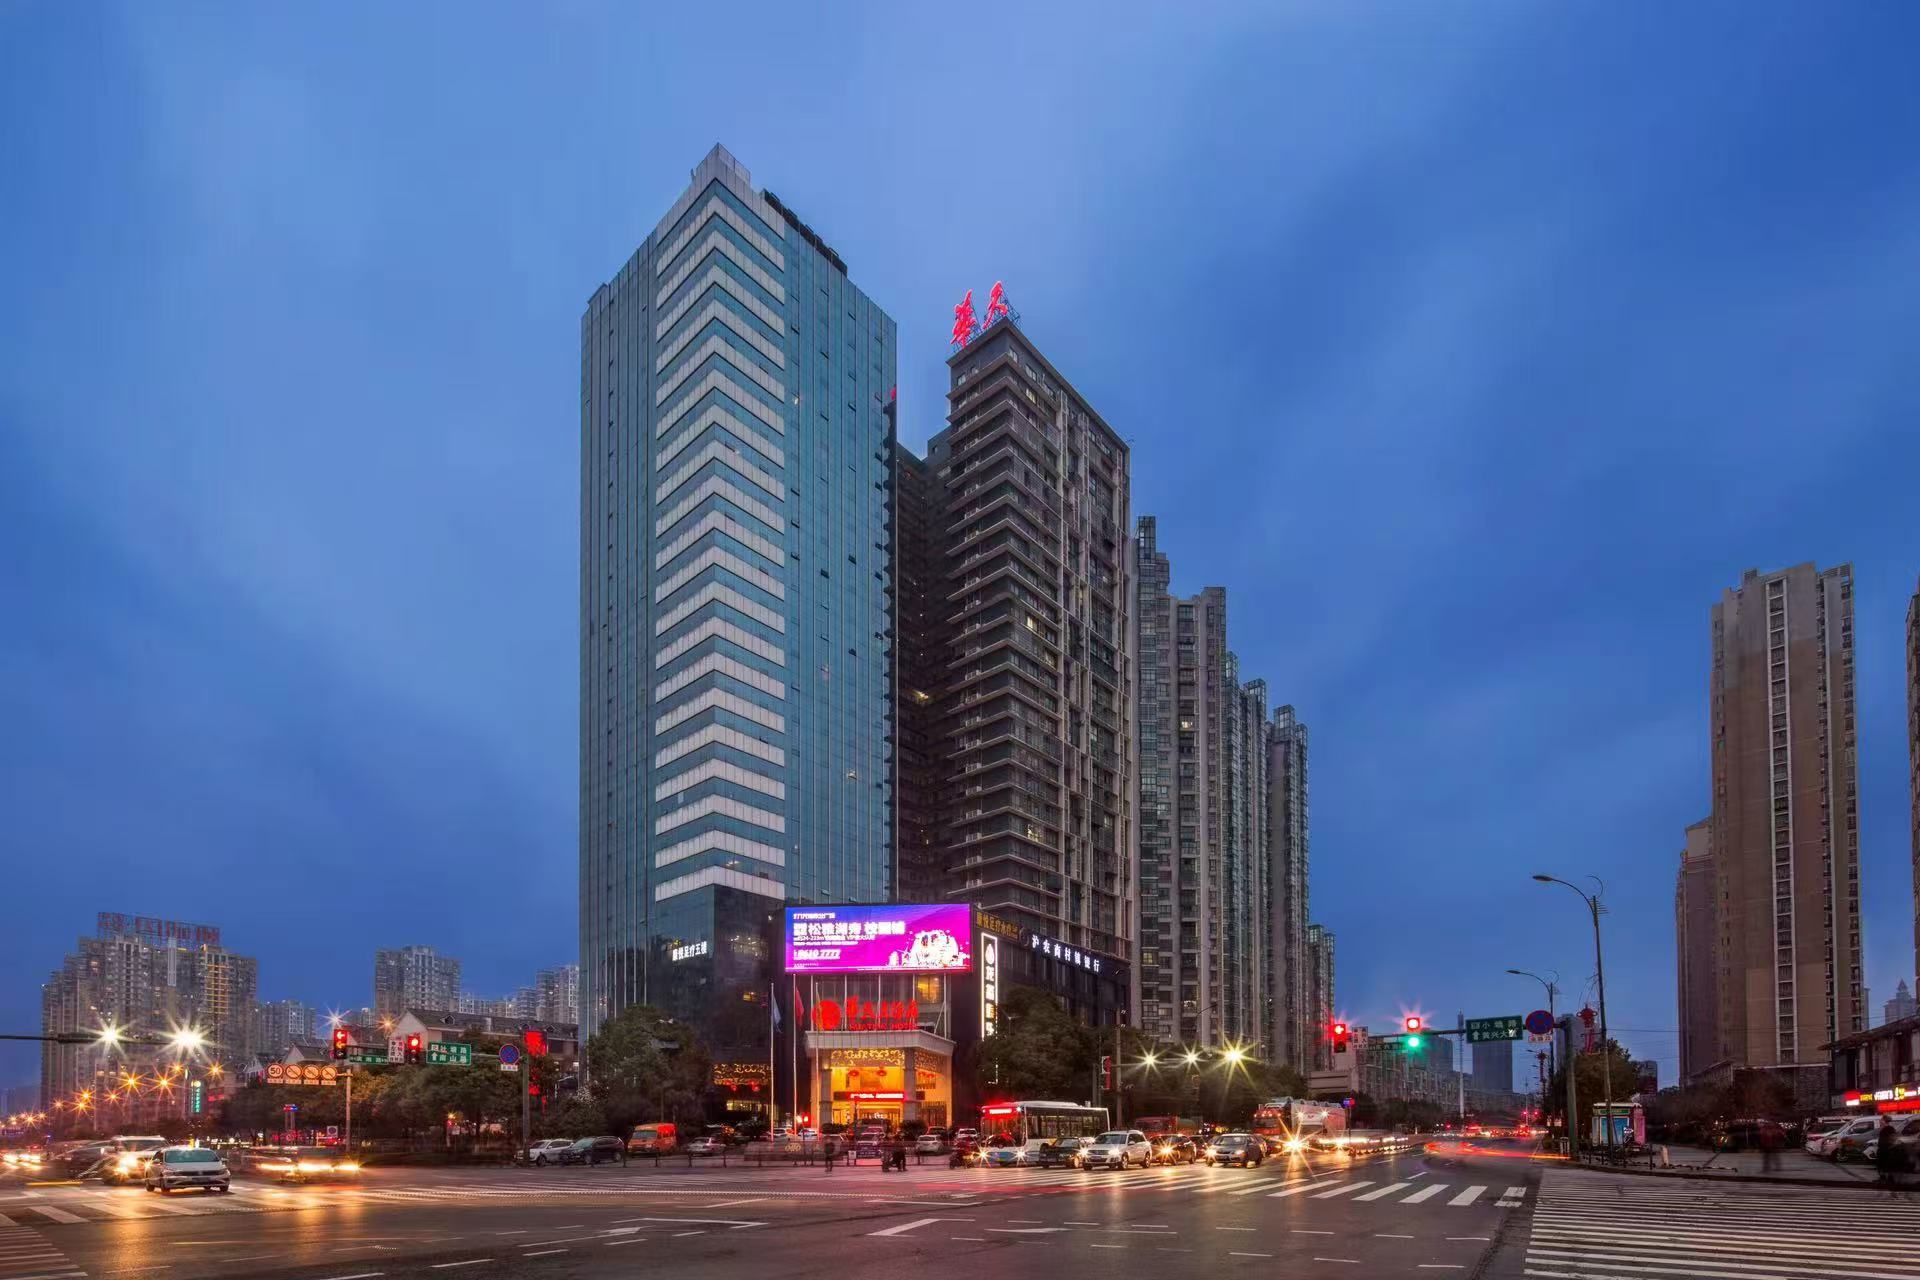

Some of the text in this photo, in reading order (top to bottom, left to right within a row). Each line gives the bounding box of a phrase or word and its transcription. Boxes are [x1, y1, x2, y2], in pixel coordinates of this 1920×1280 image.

[1031, 934, 1100, 973] 沪农商村镇银行
[270, 1067, 281, 1075] 50
